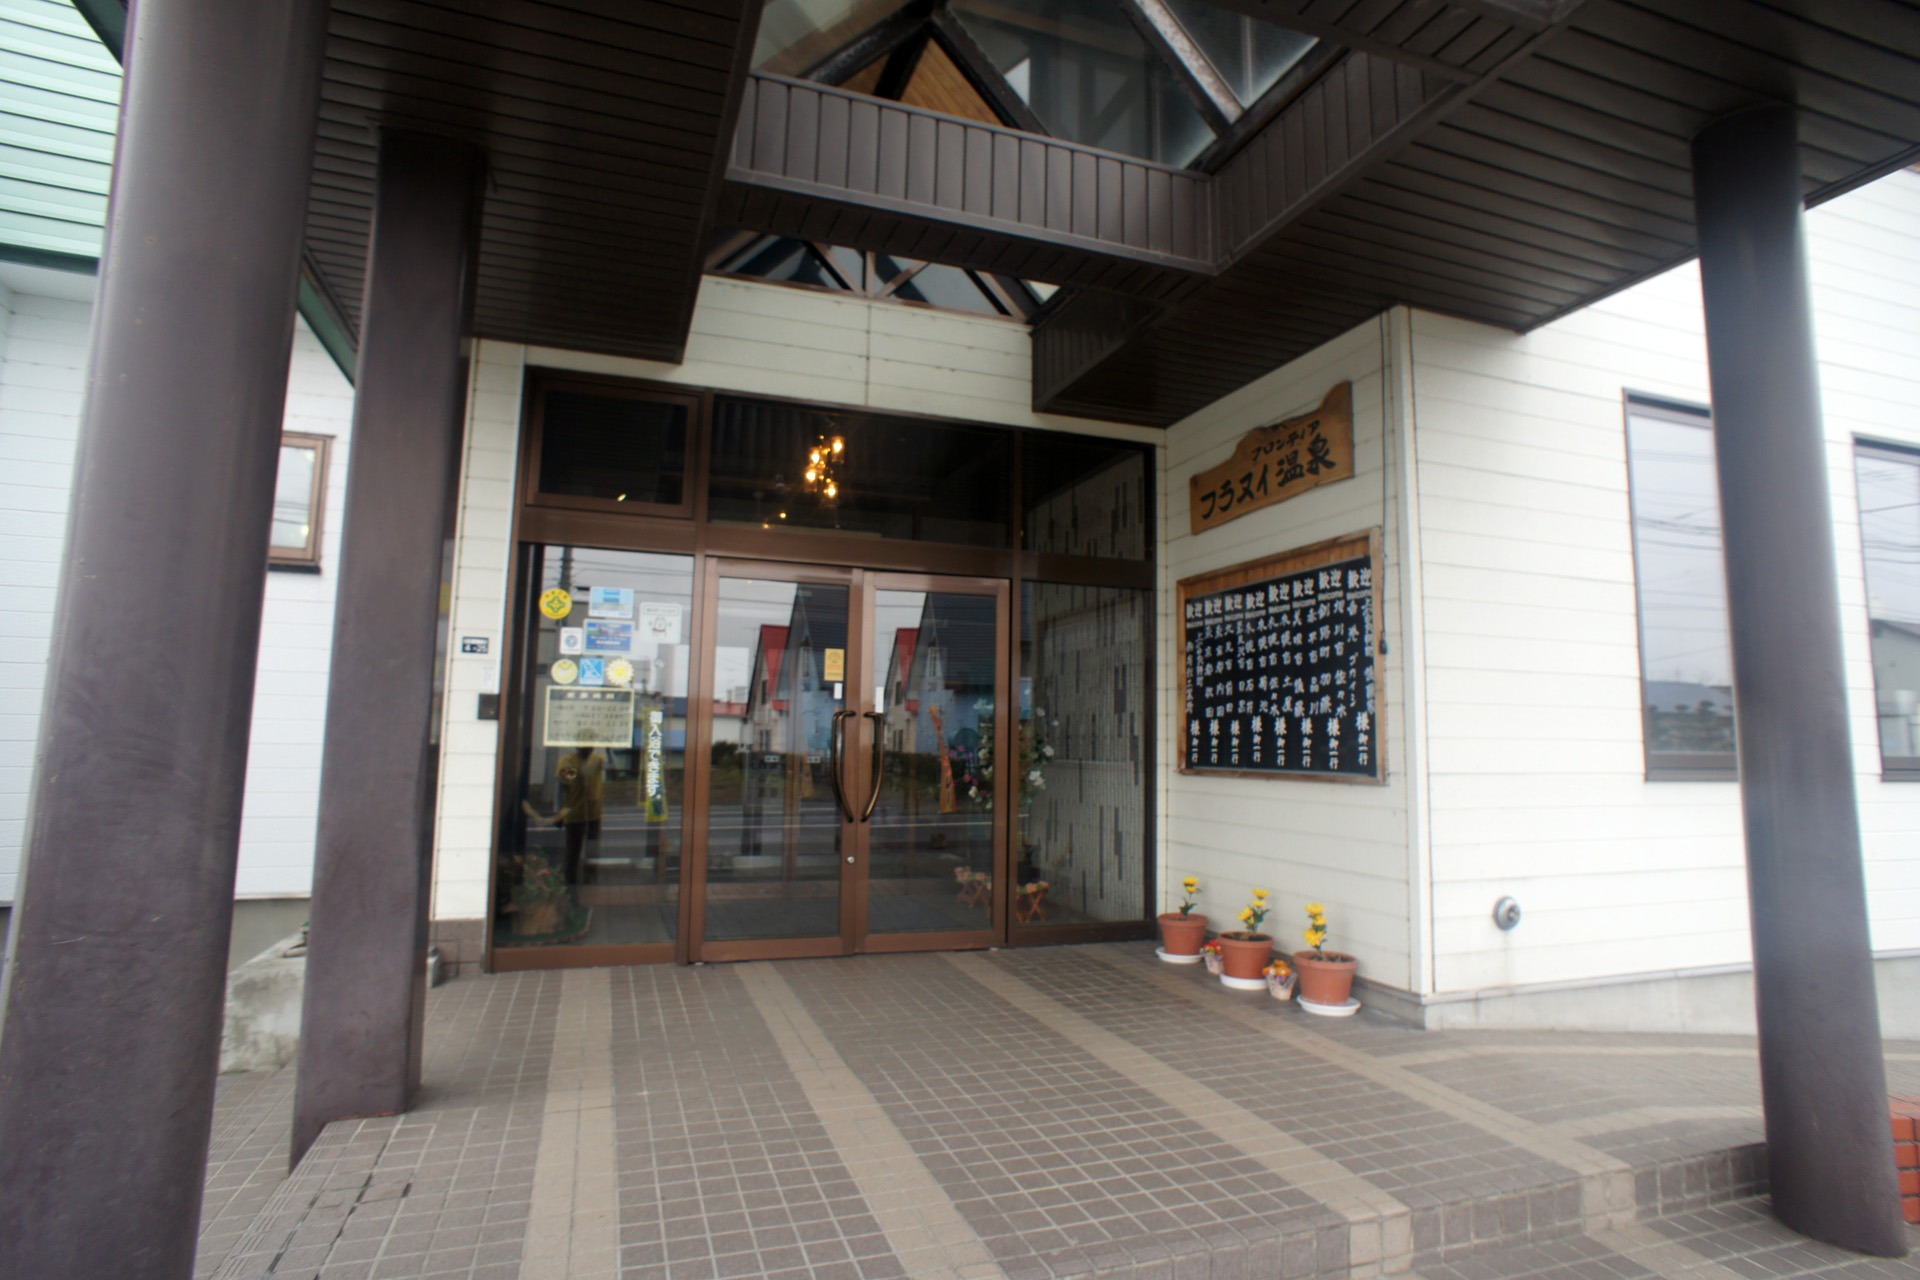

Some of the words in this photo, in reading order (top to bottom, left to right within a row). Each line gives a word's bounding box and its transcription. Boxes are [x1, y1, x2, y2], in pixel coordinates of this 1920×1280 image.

[1200, 432, 1336, 520] フラヌイ温泉
